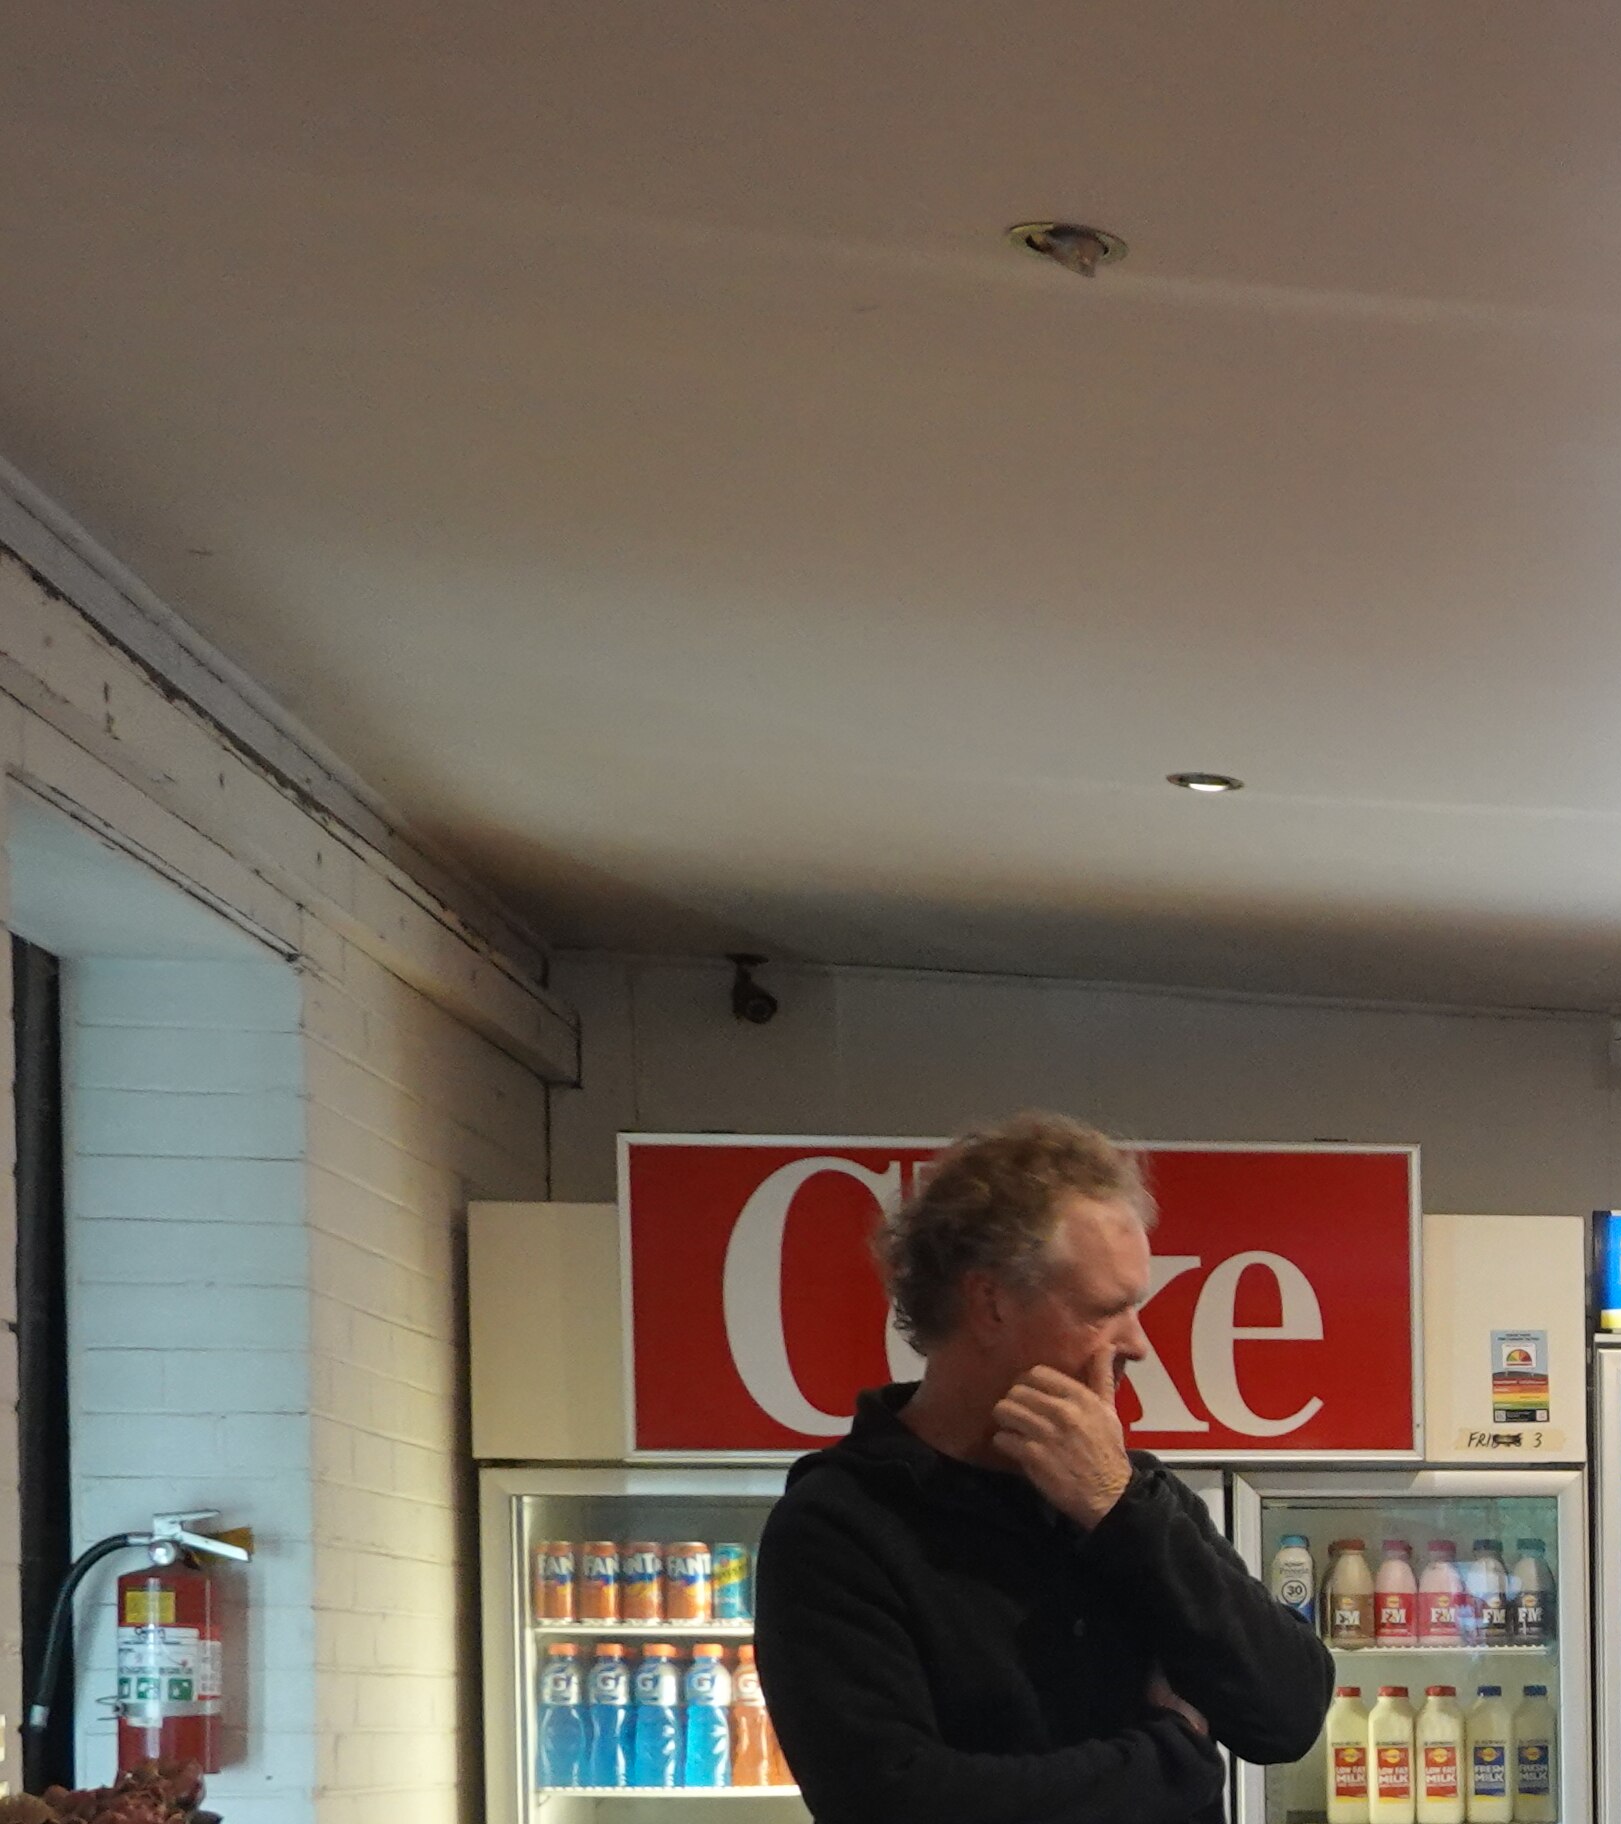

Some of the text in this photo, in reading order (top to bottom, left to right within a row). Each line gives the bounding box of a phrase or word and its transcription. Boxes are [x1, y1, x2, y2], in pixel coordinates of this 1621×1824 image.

[723, 1157, 1324, 1437] Cke
[1336, 1773, 1366, 1783] MILK
[1379, 1773, 1409, 1783] MILK
[1426, 1773, 1456, 1783] MILK
[1475, 1773, 1506, 1783] MILK
[1519, 1773, 1549, 1783] MILK
